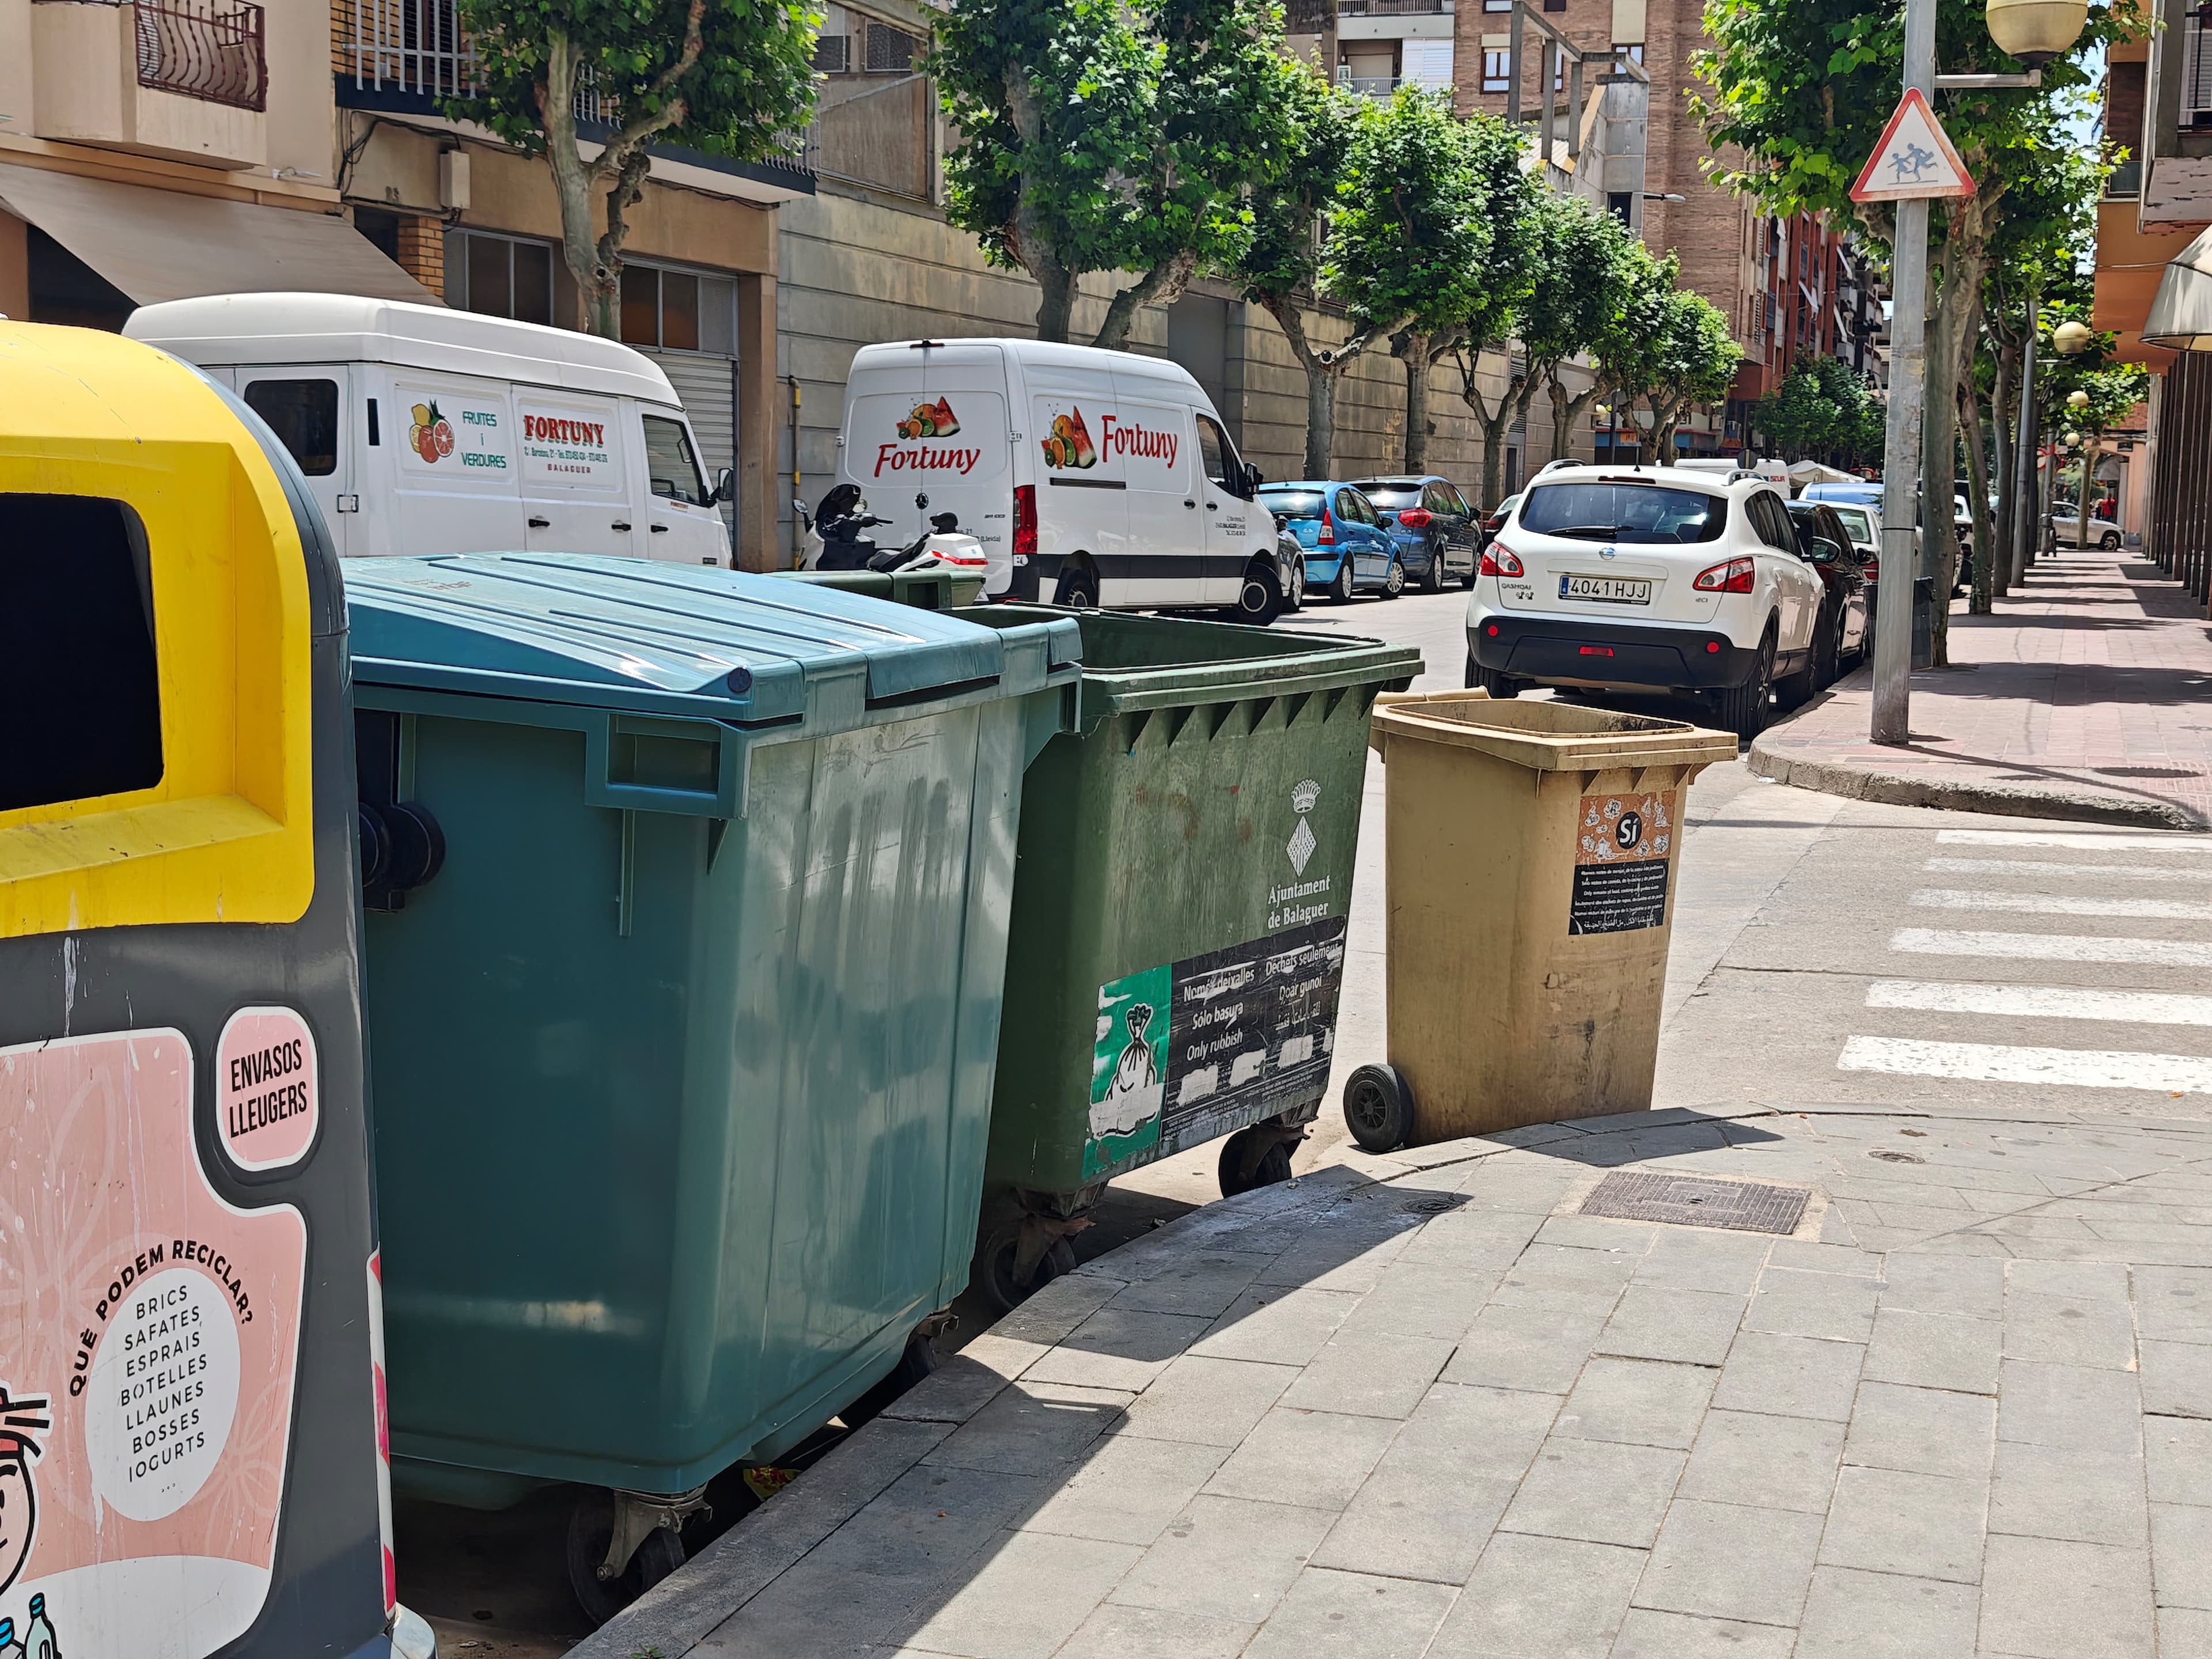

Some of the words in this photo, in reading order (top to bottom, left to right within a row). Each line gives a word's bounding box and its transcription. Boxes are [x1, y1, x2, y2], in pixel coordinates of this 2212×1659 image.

[462, 410, 497, 427] FRUITES
[523, 415, 604, 448] FORTUNY
[1101, 415, 1178, 469] Fortuny
[461, 452, 507, 469] VERDURES
[874, 442, 981, 478] Fortuny
[1570, 579, 1609, 596] 4041
[1615, 582, 1646, 598] HJJ
[1619, 817, 1639, 844] Sí
[1268, 874, 1331, 908] Ajuntament
[1268, 911, 1281, 930] de
[1283, 902, 1329, 925] Balaguer
[1300, 972, 1323, 998] gunoi
[1192, 1009, 1213, 1031] Sólo
[1214, 1002, 1244, 1023] basura
[1187, 1040, 1209, 1061] Only
[1210, 1028, 1243, 1054] rubbish
[230, 1039, 302, 1092] ENVASOS
[229, 1081, 307, 1138] LLEUGERS
[69, 1327, 98, 1397] QUÈ
[95, 1243, 164, 1322] PODEM
[172, 1239, 253, 1325] RECICLAR?
[136, 1285, 188, 1320] BRICS
[124, 1305, 200, 1351] SAFATES
[126, 1331, 200, 1377] ESPRAIS
[120, 1354, 207, 1407] BOTELLES
[126, 1381, 204, 1431] LLAUNES
[132, 1409, 200, 1455] BOSSES
[128, 1431, 206, 1483] IOGURTS
